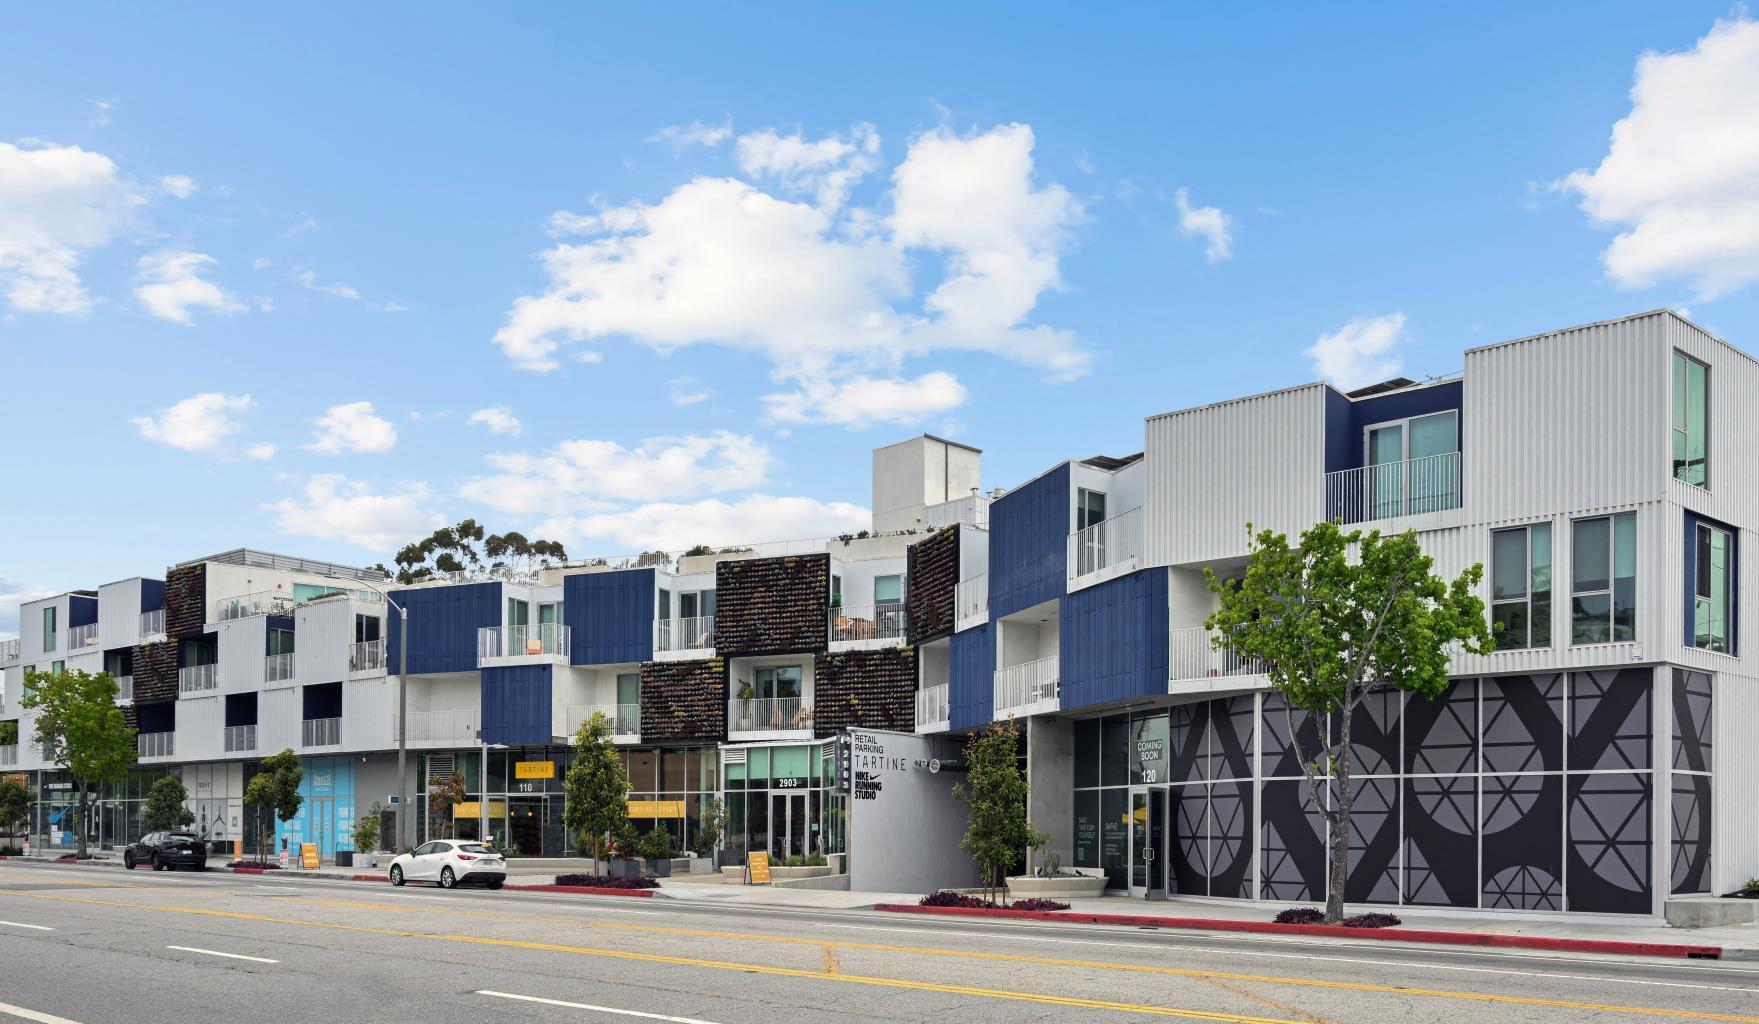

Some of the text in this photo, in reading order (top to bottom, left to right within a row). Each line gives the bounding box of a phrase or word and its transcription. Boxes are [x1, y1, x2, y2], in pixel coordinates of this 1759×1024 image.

[855, 735, 877, 744] RETAIL
[855, 744, 883, 753] PARKING
[1137, 740, 1162, 751] COMING
[1141, 751, 1158, 760] SOON
[855, 755, 906, 770] TARTINE
[855, 771, 869, 781] NIKE
[1142, 769, 1157, 783] 120
[519, 783, 533, 792] 110
[779, 778, 797, 788] 2903
[855, 781, 882, 791] RUNNING
[855, 791, 876, 800] STUDIO
